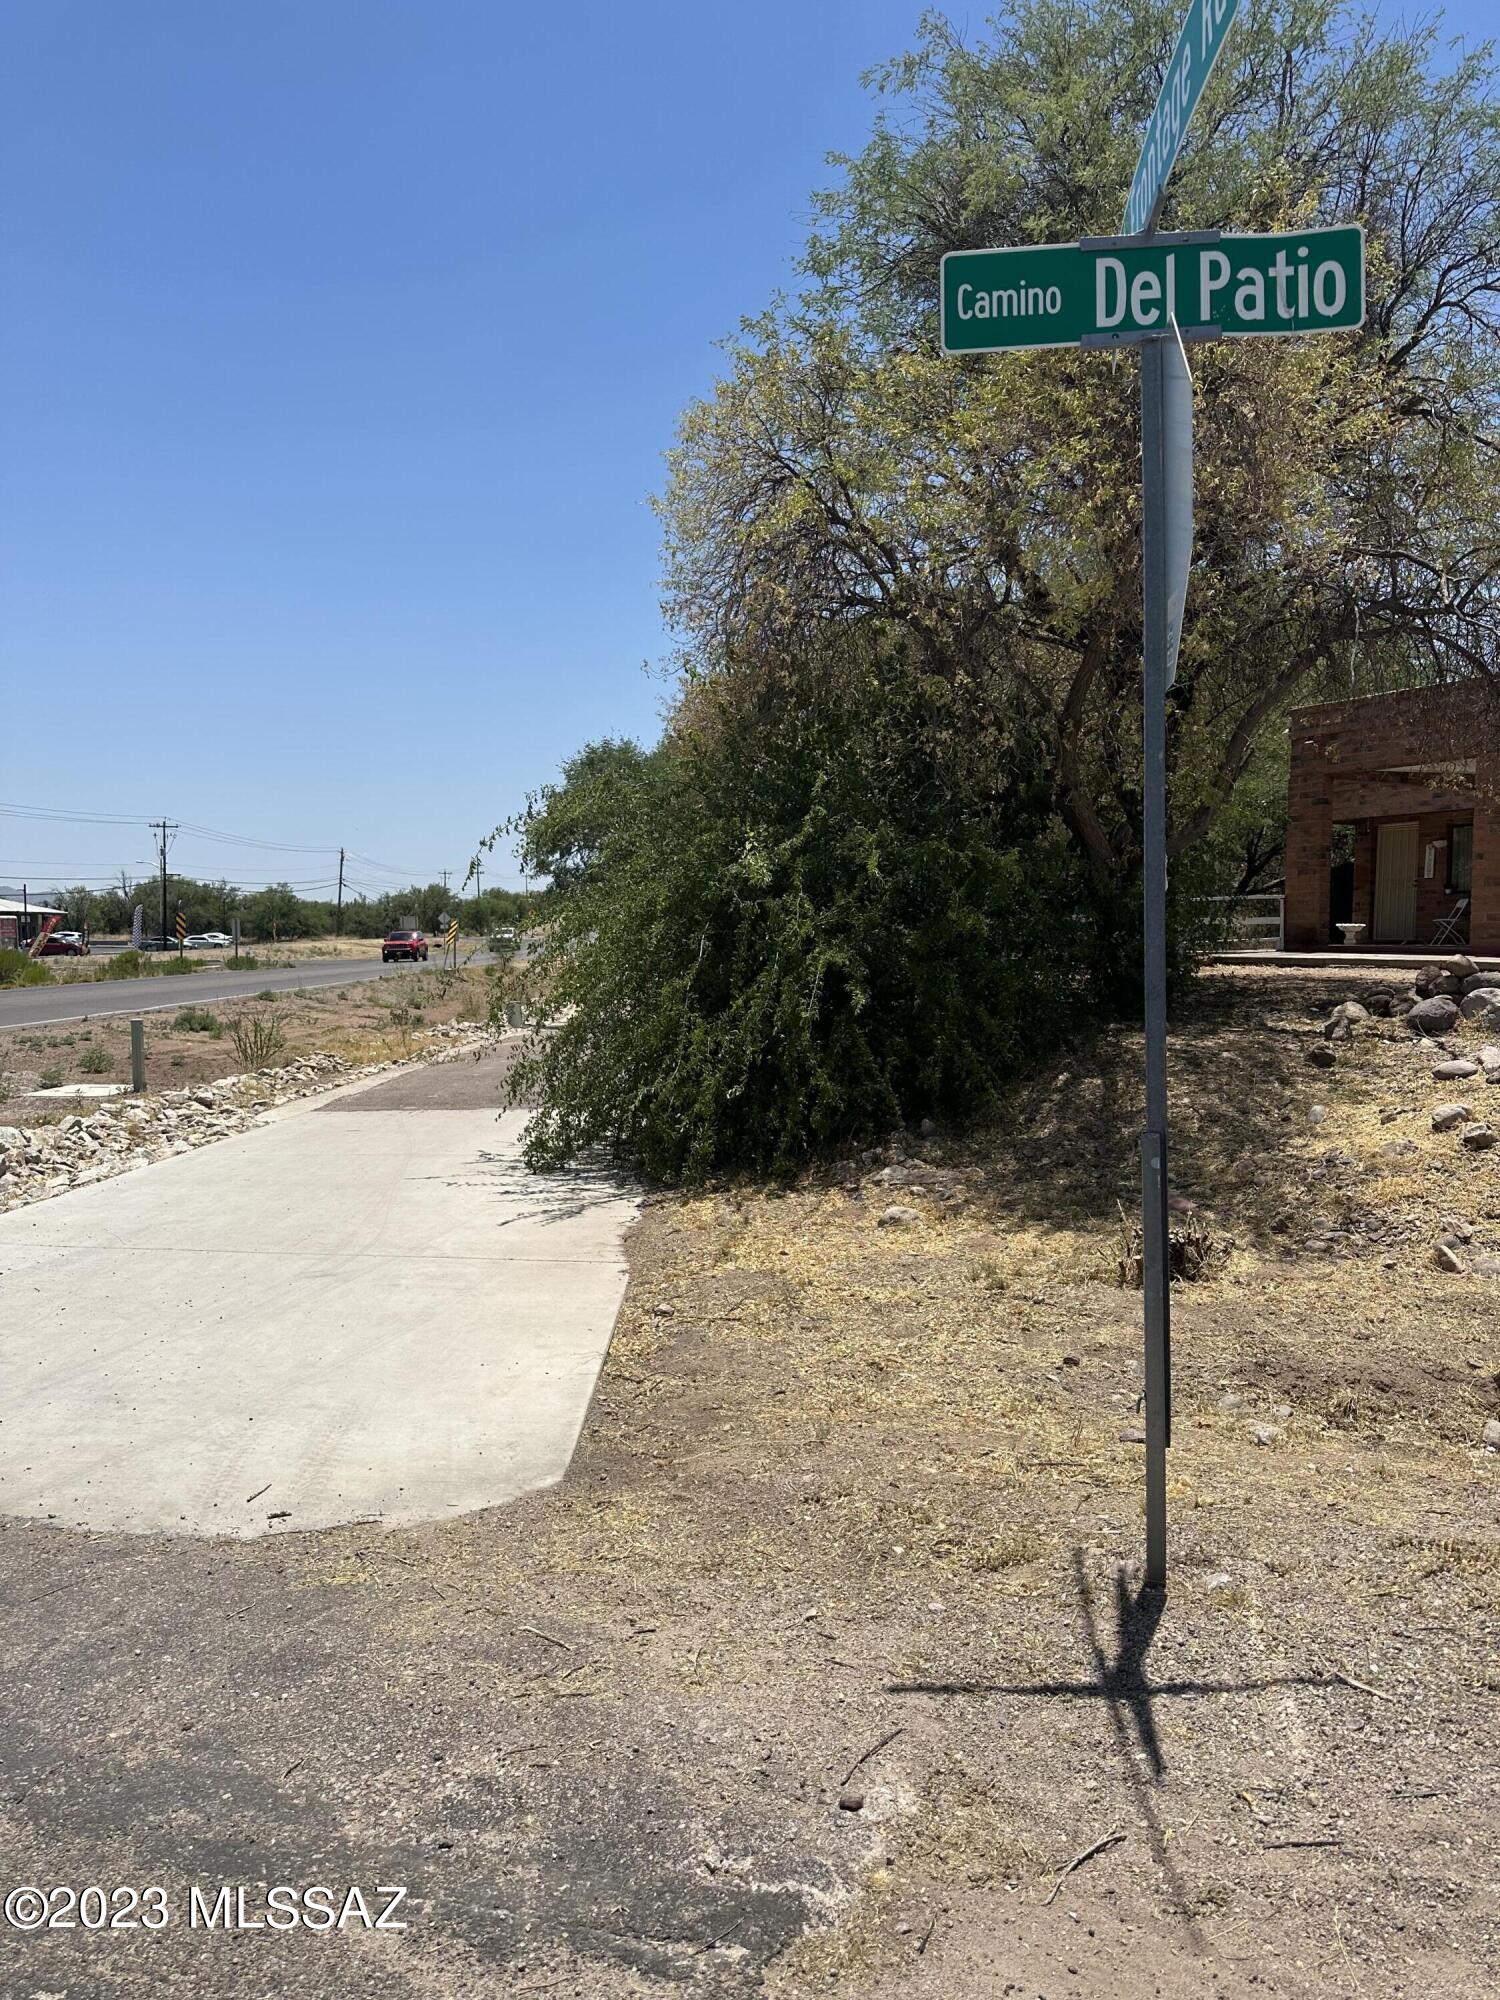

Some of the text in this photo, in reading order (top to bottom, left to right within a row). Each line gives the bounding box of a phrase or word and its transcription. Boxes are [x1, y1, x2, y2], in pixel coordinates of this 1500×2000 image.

[957, 246, 1346, 328] Camino Del Patio
